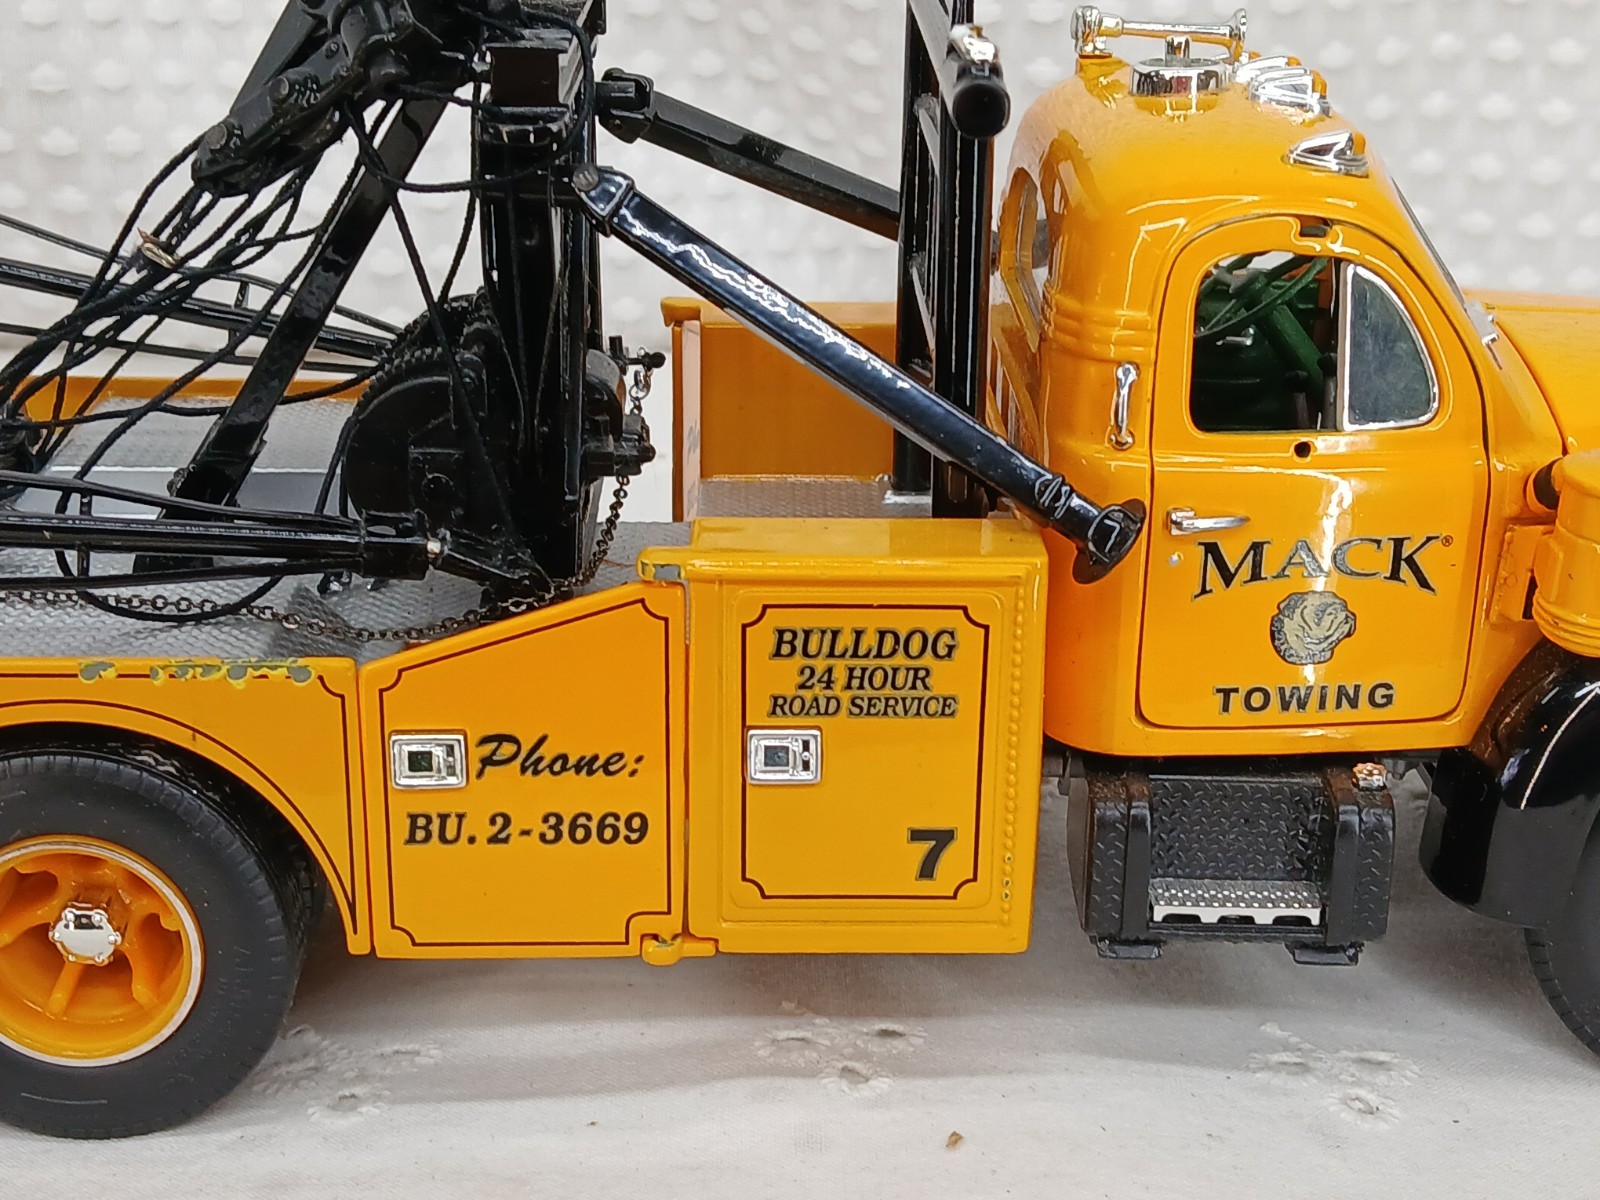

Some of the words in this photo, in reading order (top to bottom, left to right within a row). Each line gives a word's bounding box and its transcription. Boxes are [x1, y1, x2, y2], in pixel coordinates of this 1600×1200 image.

[769, 627, 957, 661] BULLDOG
[796, 666, 838, 691] 24
[842, 665, 932, 692] HOUR
[768, 694, 841, 718] ROAD
[848, 695, 959, 718] SERVICE
[1213, 681, 1395, 714] TOWING
[475, 733, 645, 780] Phone:
[907, 826, 957, 881] 7
